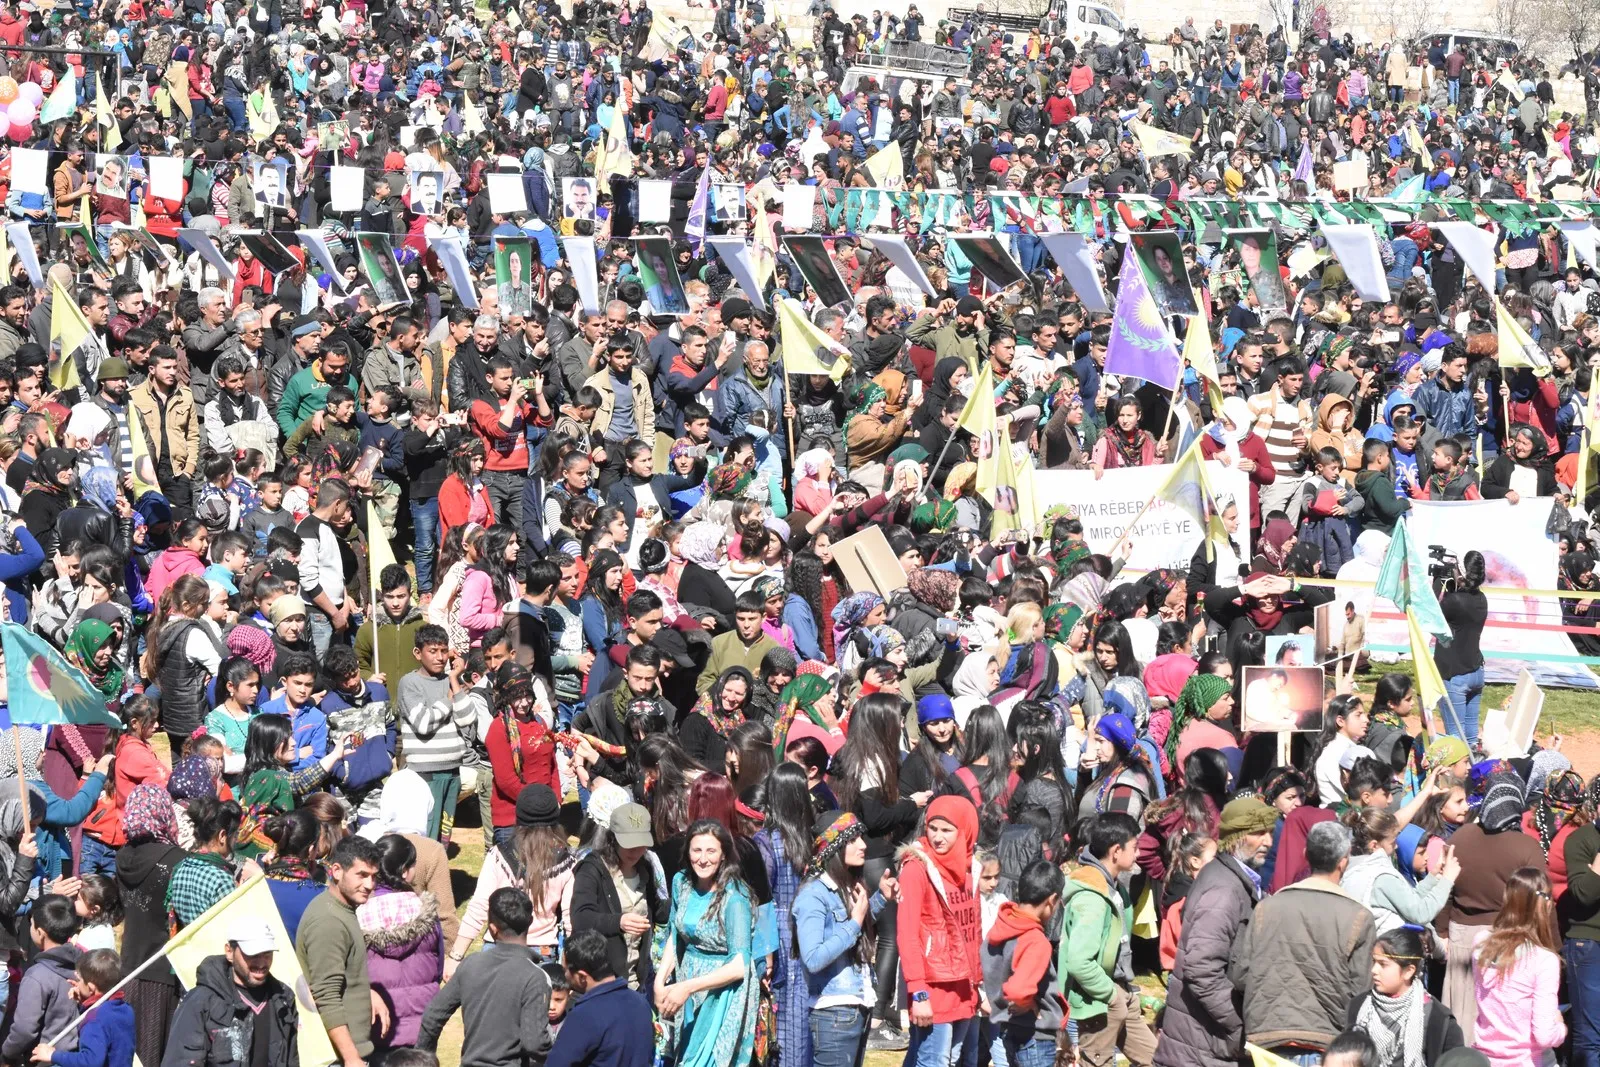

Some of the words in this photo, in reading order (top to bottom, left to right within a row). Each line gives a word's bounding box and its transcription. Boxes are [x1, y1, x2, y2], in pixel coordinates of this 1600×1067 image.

[1100, 500, 1144, 516] RÊBER
[1175, 520, 1191, 534] YE
[946, 889, 974, 904] EELIN
